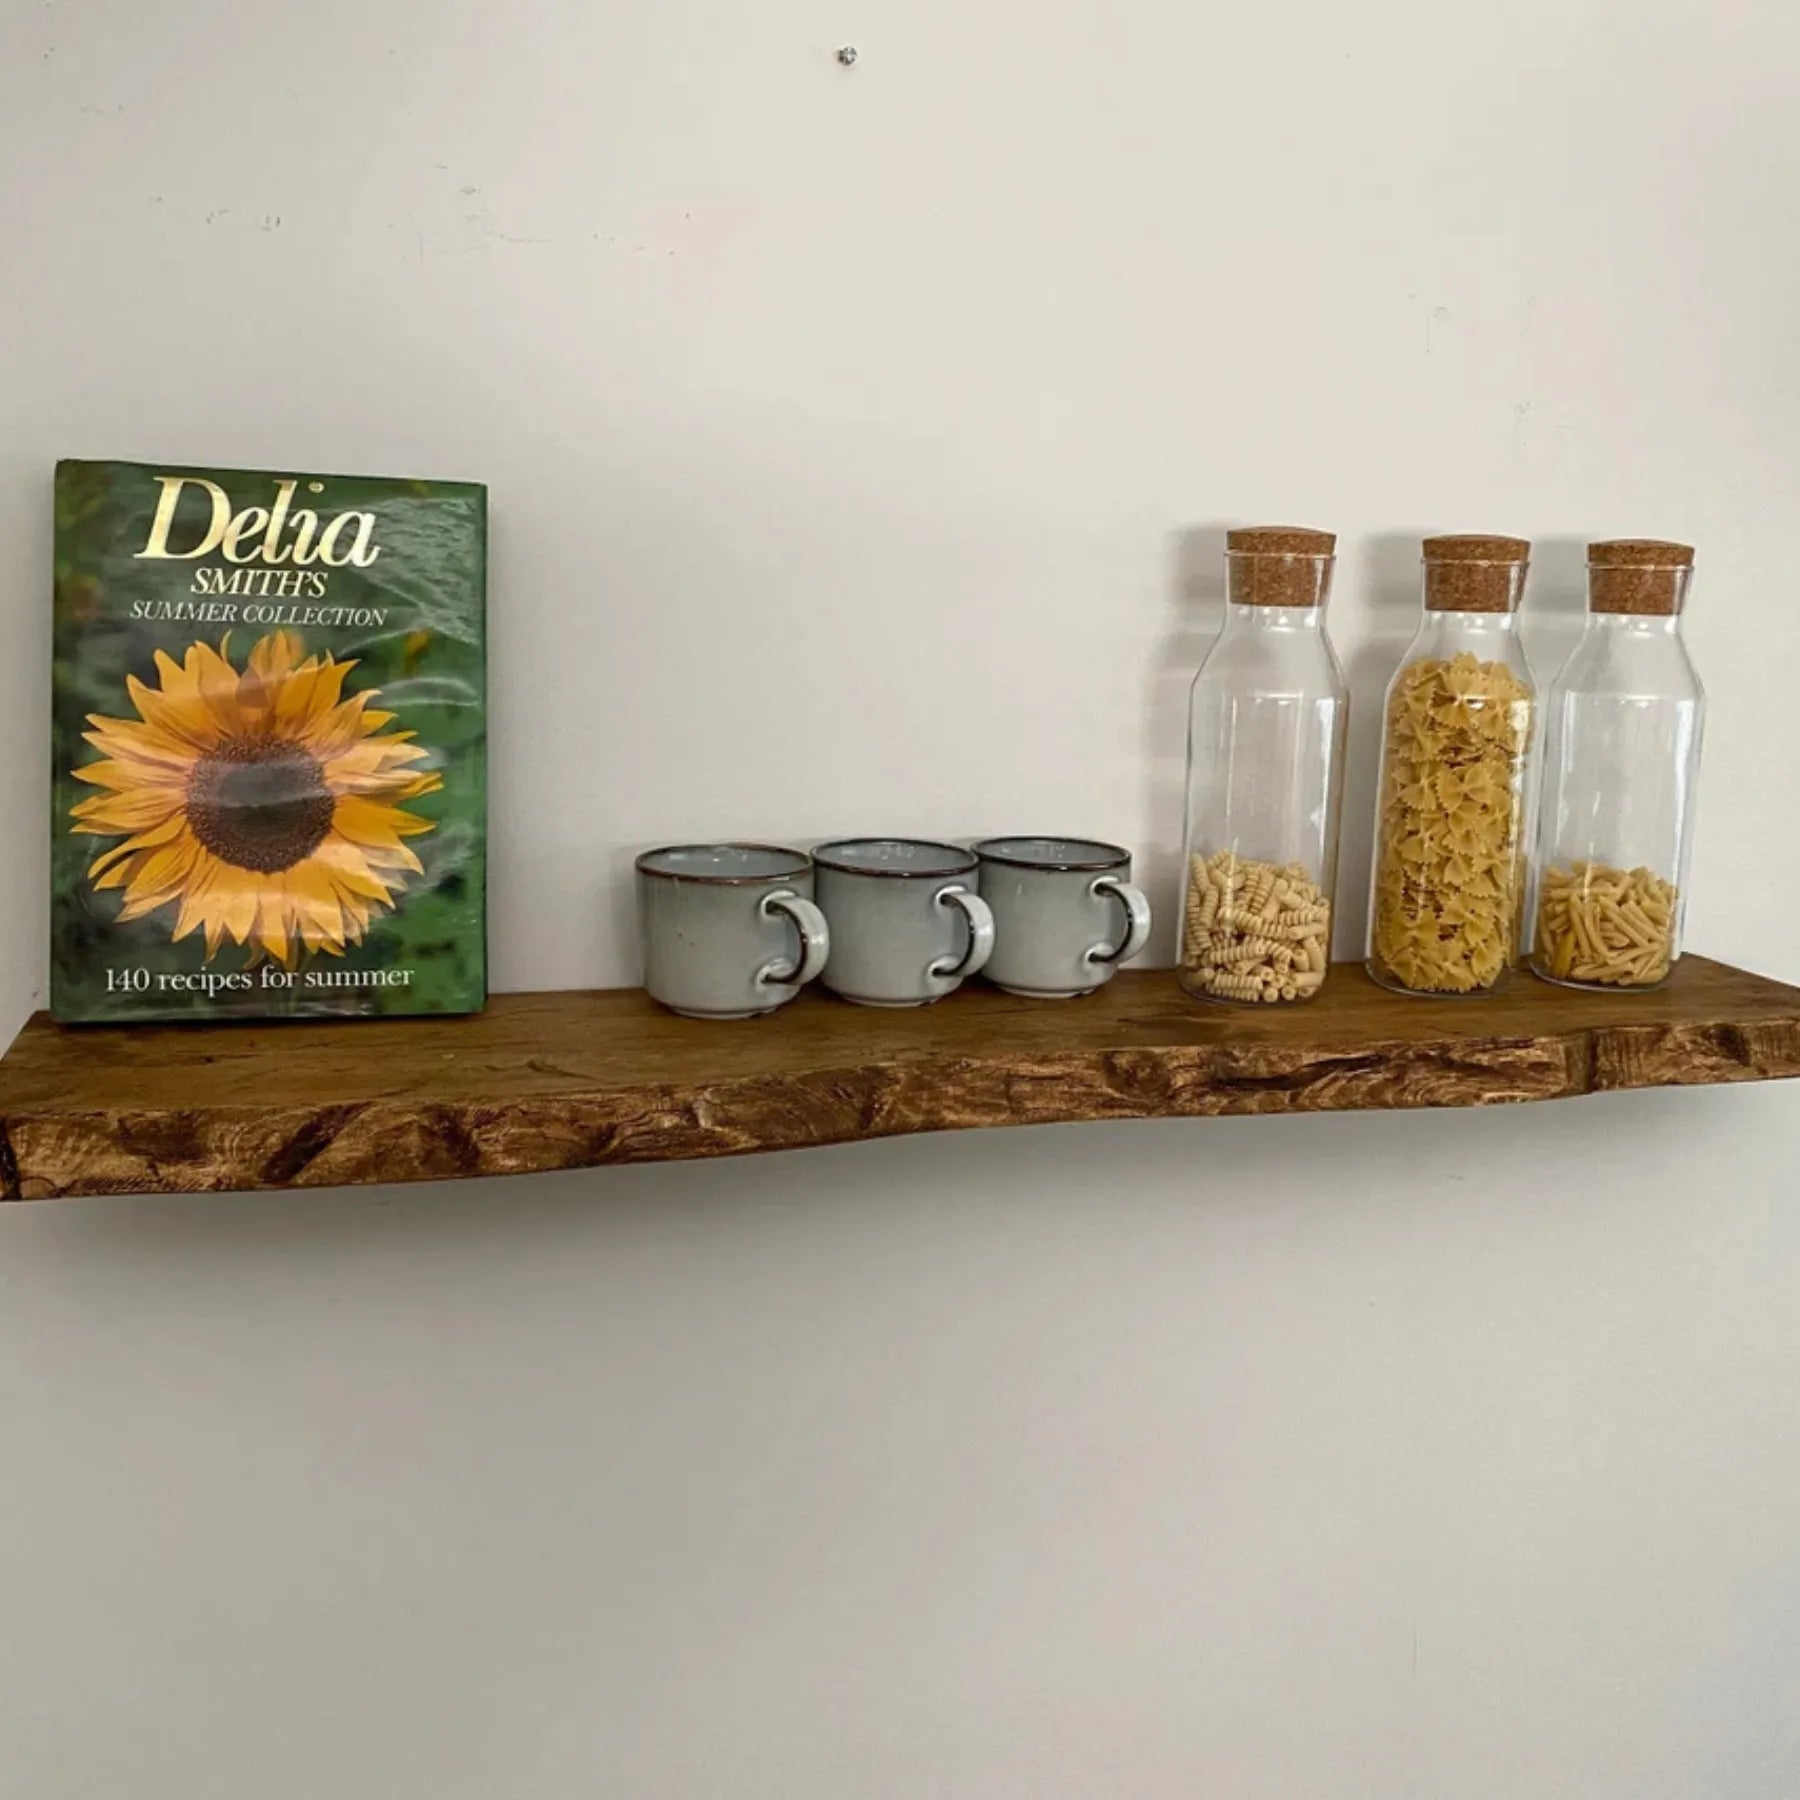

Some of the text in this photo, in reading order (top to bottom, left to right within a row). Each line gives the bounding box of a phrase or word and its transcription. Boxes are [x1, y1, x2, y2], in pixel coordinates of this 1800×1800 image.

[133, 476, 381, 567] Delia
[190, 567, 328, 598] SMITH'S
[129, 600, 388, 626] SUMMER COLLECTION
[105, 965, 415, 997] 140 recipes for summer
